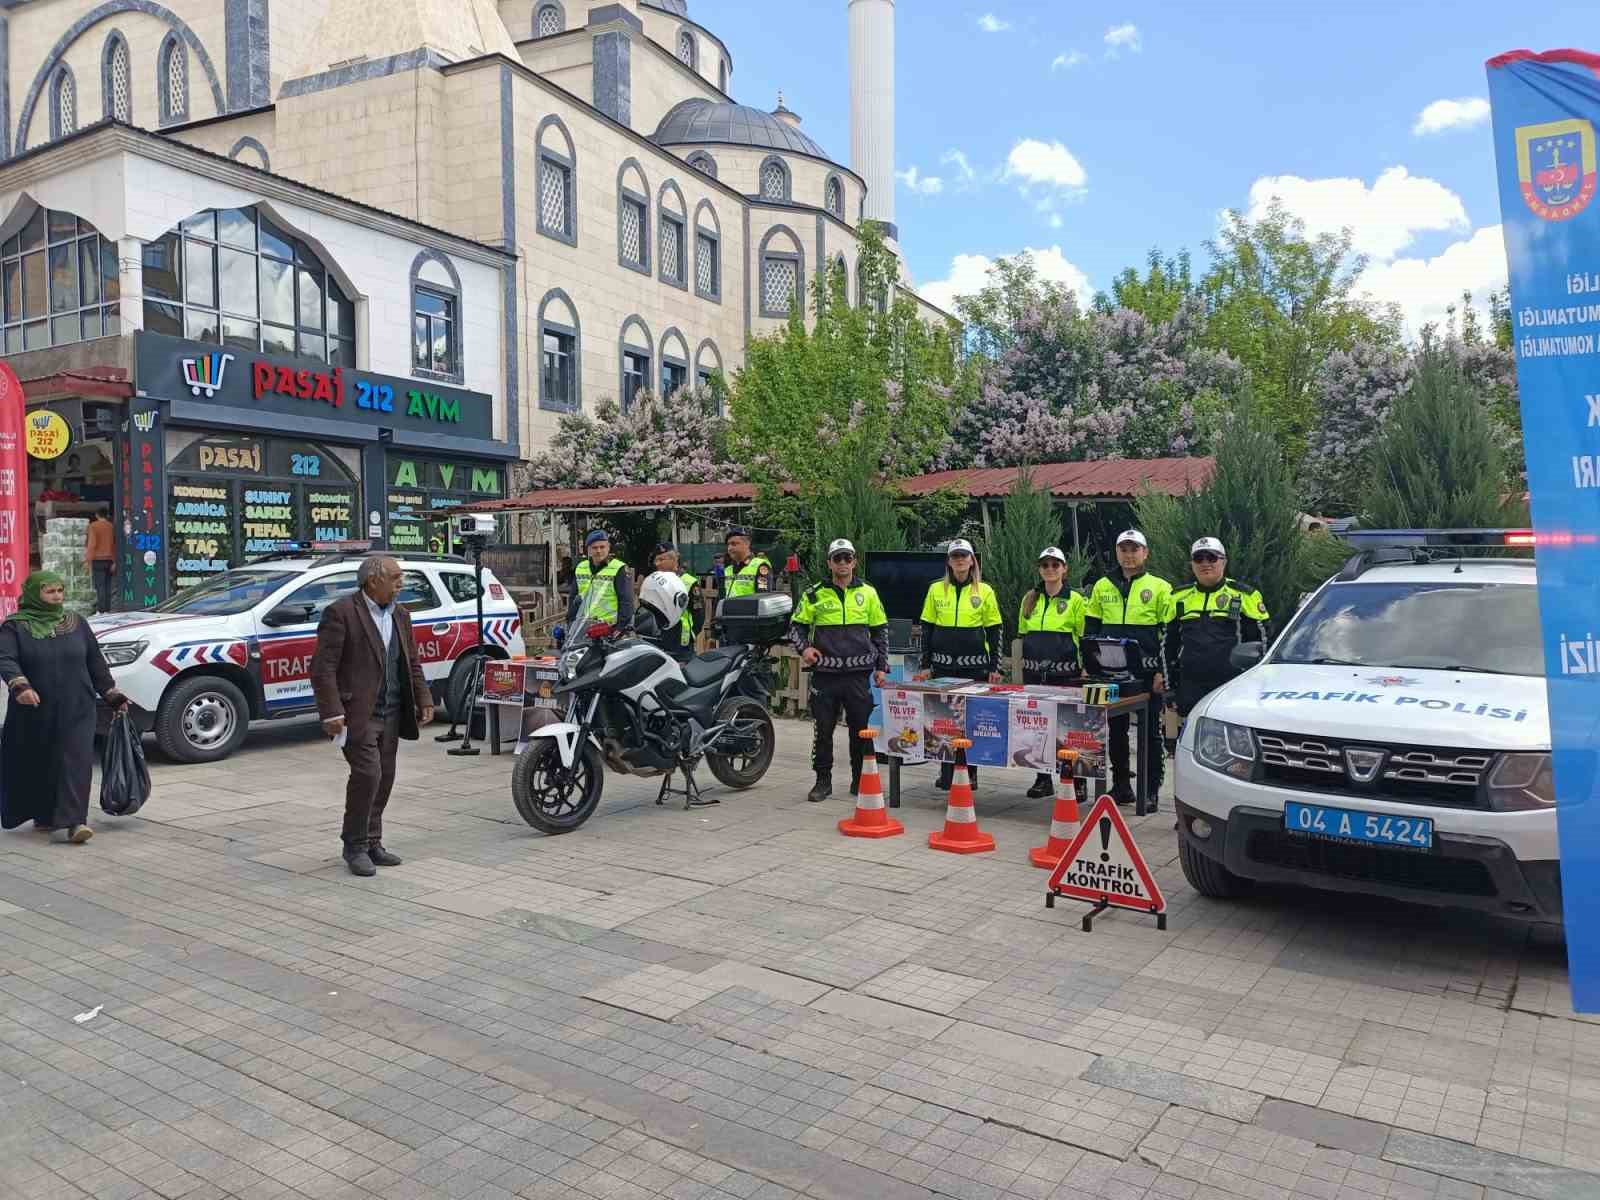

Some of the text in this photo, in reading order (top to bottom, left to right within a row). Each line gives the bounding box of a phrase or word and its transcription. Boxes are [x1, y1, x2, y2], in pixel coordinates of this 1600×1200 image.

[354, 379, 394, 413] 212
[406, 388, 463, 424] AVM
[33, 446, 58, 454] AVM
[37, 437, 53, 445] 212
[290, 453, 320, 476] 212
[311, 505, 350, 524] ÇEYİZ
[175, 521, 228, 535] KARACA
[243, 522, 291, 538] TEFAL
[135, 532, 161, 550] 212
[185, 539, 219, 557] TAÇ
[1257, 690, 1529, 722] TRAFİK POLİSİ
[1299, 807, 1327, 832] 04
[1338, 812, 1352, 836] A
[1365, 816, 1428, 845] 5424
[1075, 859, 1135, 881] TRAFİK
[1066, 871, 1144, 897] KONTROL
